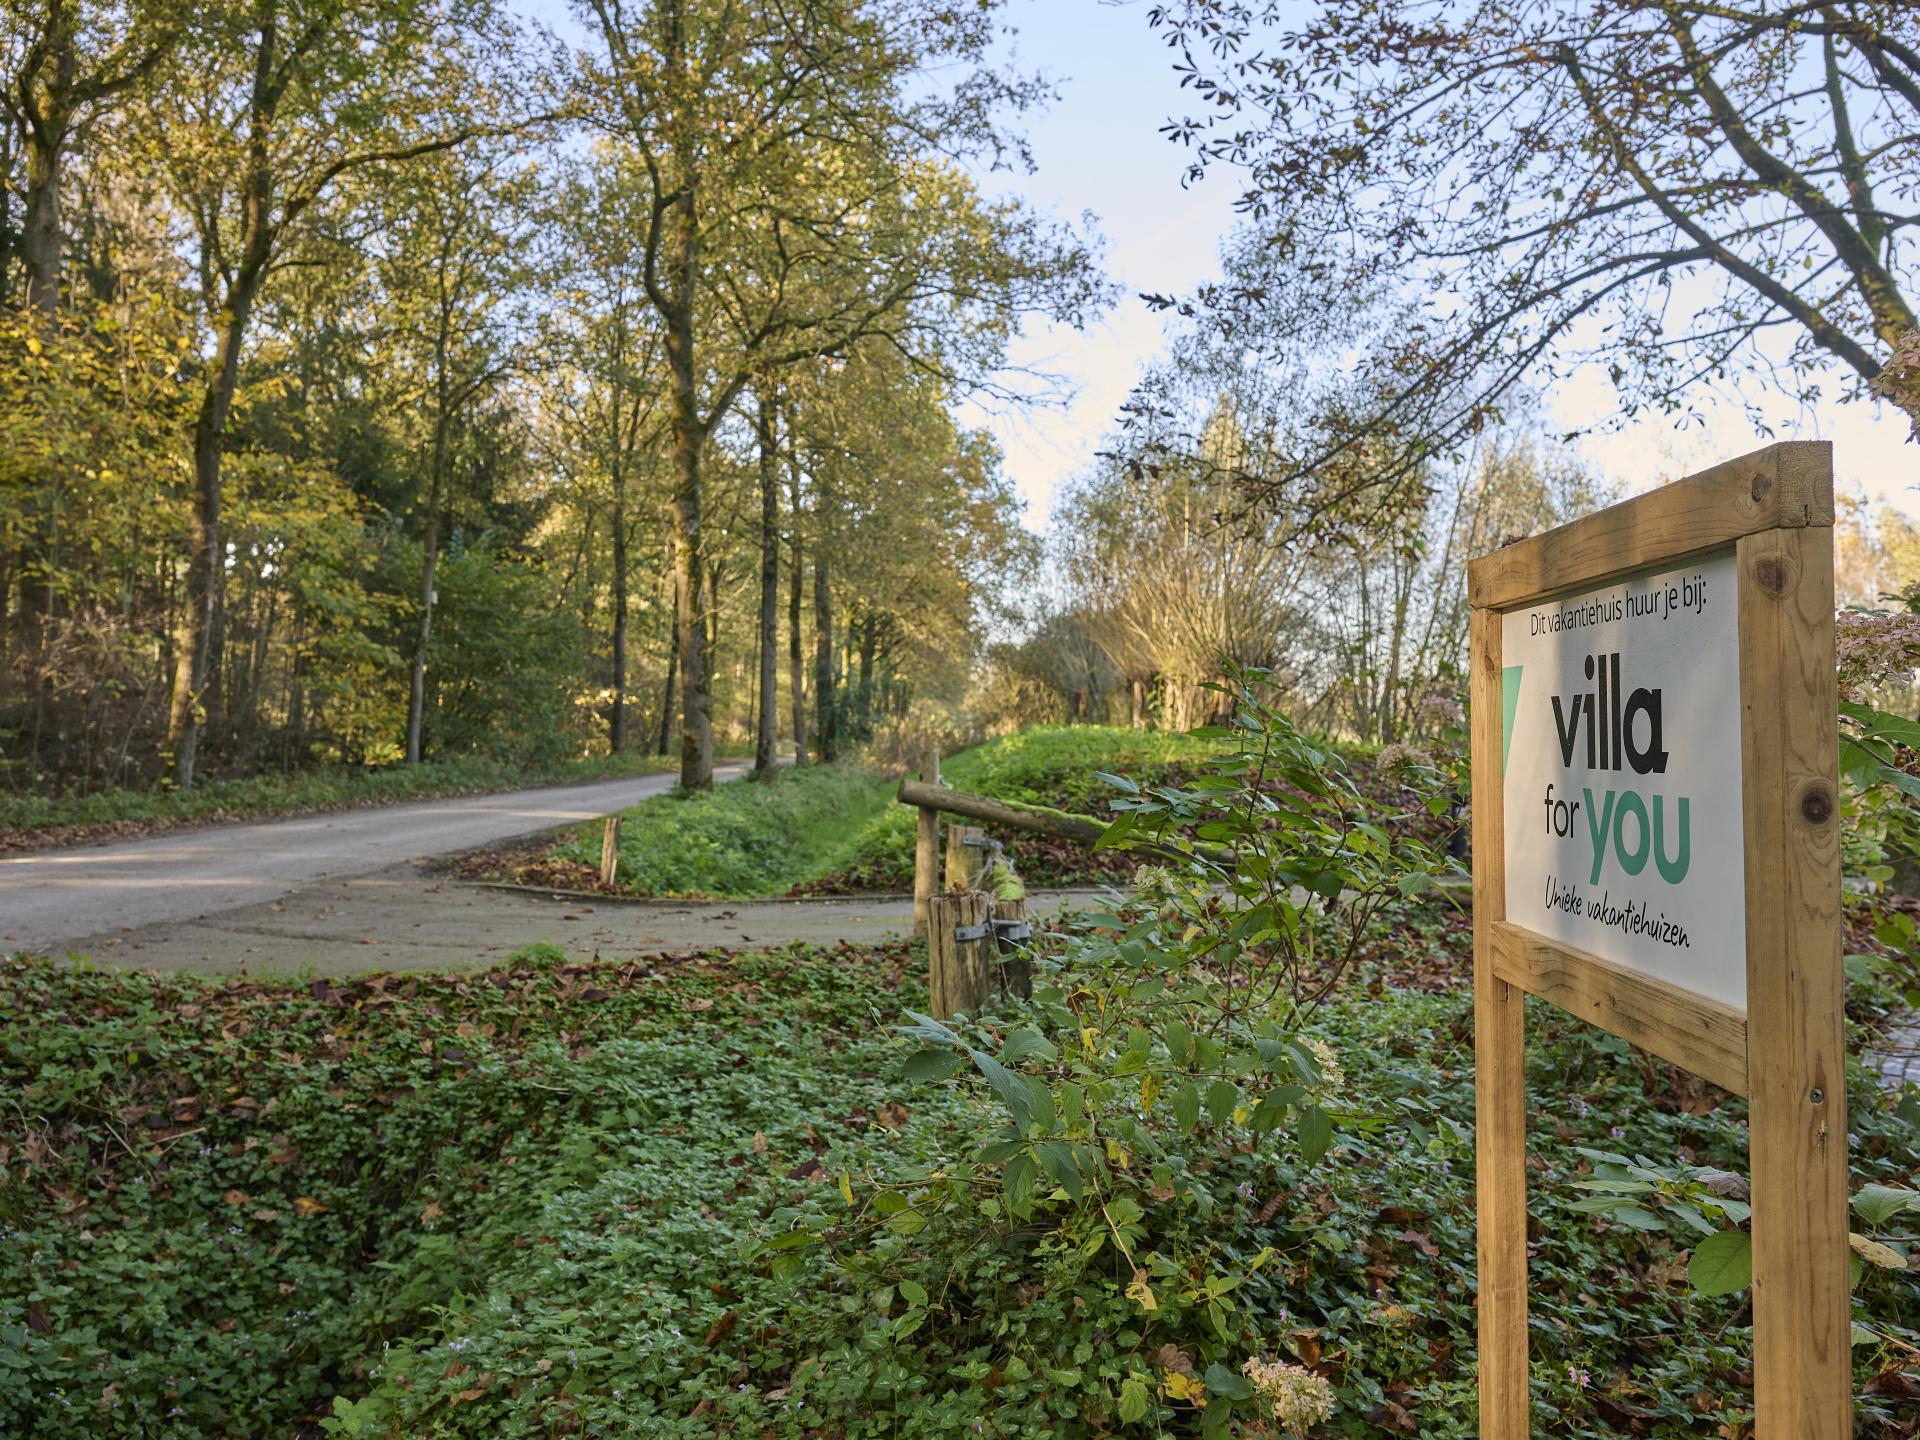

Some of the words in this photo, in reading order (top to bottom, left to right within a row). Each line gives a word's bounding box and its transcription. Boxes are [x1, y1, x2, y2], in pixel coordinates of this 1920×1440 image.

[1531, 611, 1546, 636] Dit
[1548, 594, 1622, 633] vakantiehuis
[1626, 590, 1661, 619] huur
[1663, 582, 1678, 620] je
[1683, 574, 1707, 615] bij:
[1551, 652, 1669, 774] villa
[1544, 783, 1580, 838] for
[1545, 875, 1582, 916] Unieke
[1587, 890, 1690, 948] vakantiehuizen
